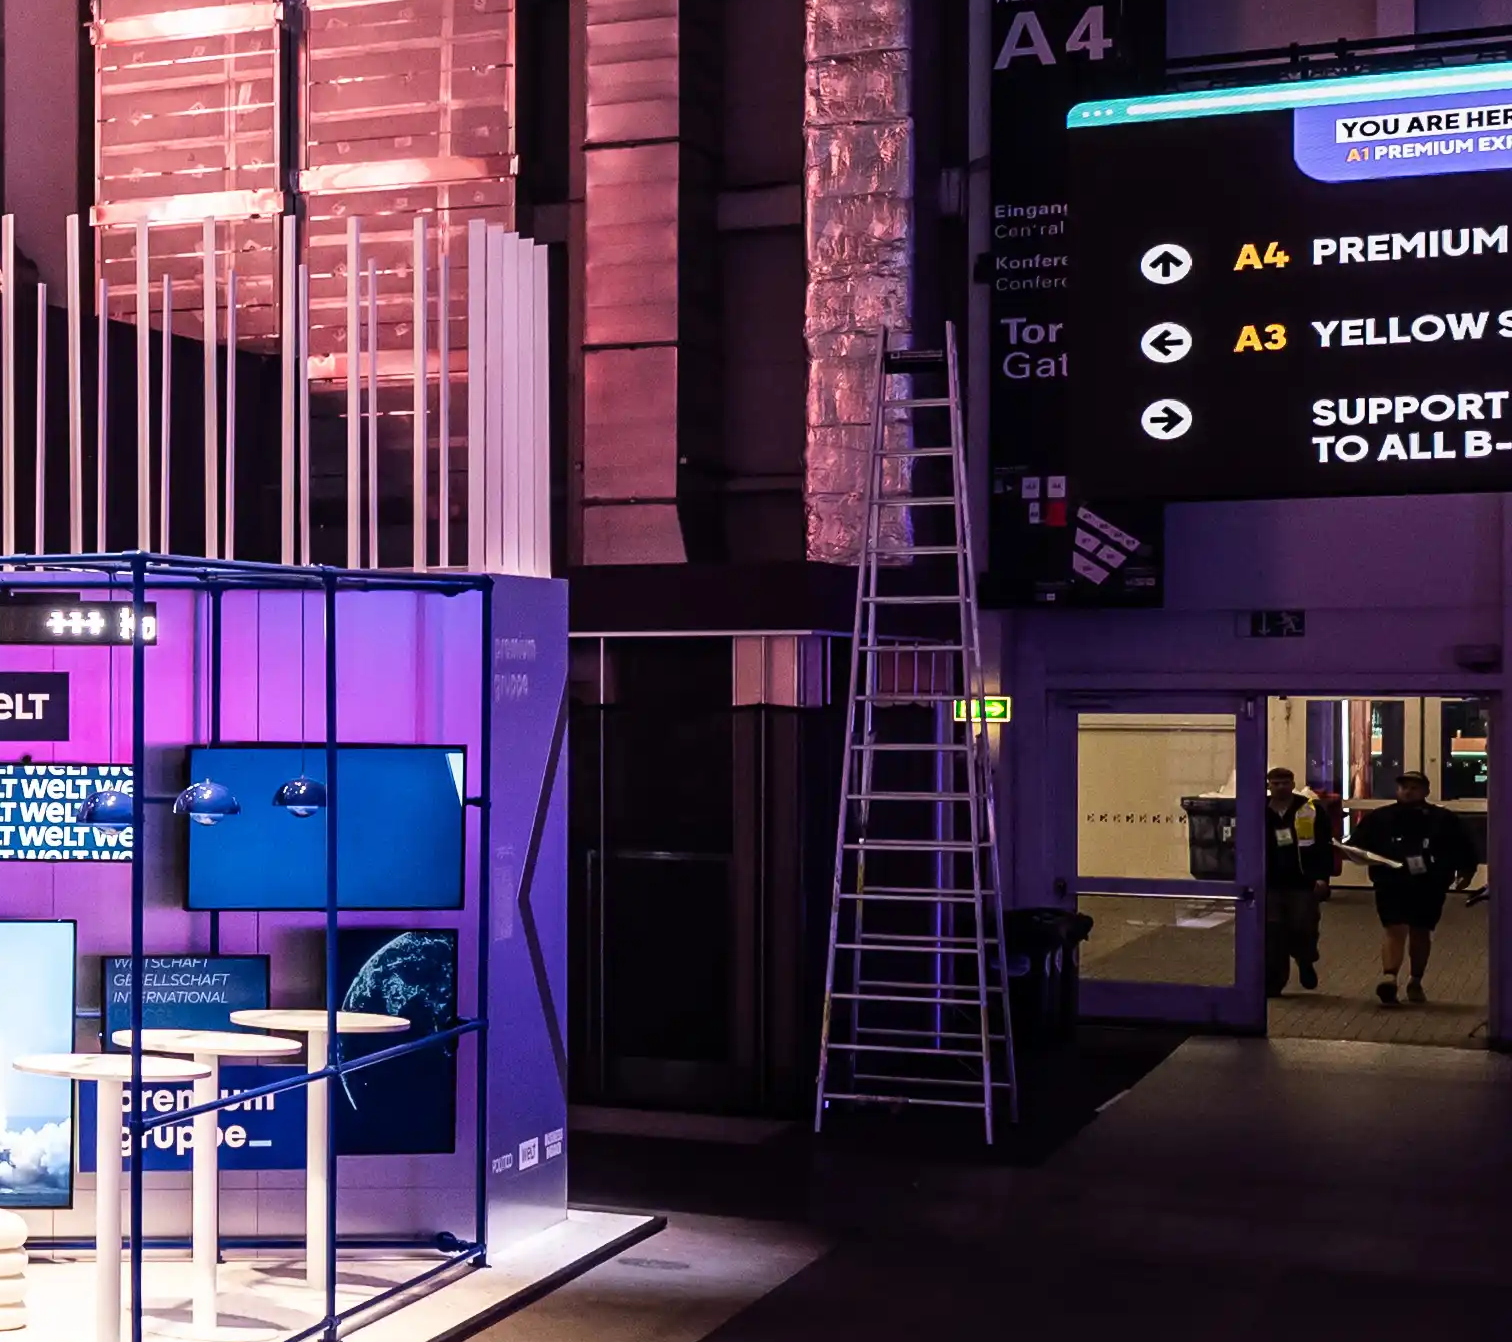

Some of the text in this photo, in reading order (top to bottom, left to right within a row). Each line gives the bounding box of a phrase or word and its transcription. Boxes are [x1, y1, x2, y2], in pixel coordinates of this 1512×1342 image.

[993, 5, 1113, 70] A4
[1342, 119, 1400, 138] YOU
[1406, 112, 1460, 134] ARE
[1346, 147, 1369, 163] A1
[1375, 137, 1474, 160] PREMIUM
[1233, 225, 1509, 271] A4 PREMIUM
[1000, 316, 1065, 345] Tor
[1233, 324, 1287, 352] A3
[1311, 311, 1490, 348] YELLOW
[1312, 390, 1510, 427] SUPPORT
[1312, 434, 1369, 463] TO
[1377, 431, 1456, 462] ALL
[114, 959, 208, 968] WITSCHAFT
[113, 973, 231, 987] GEELLSCHAFT
[113, 991, 229, 1003] INRNATIONAL
